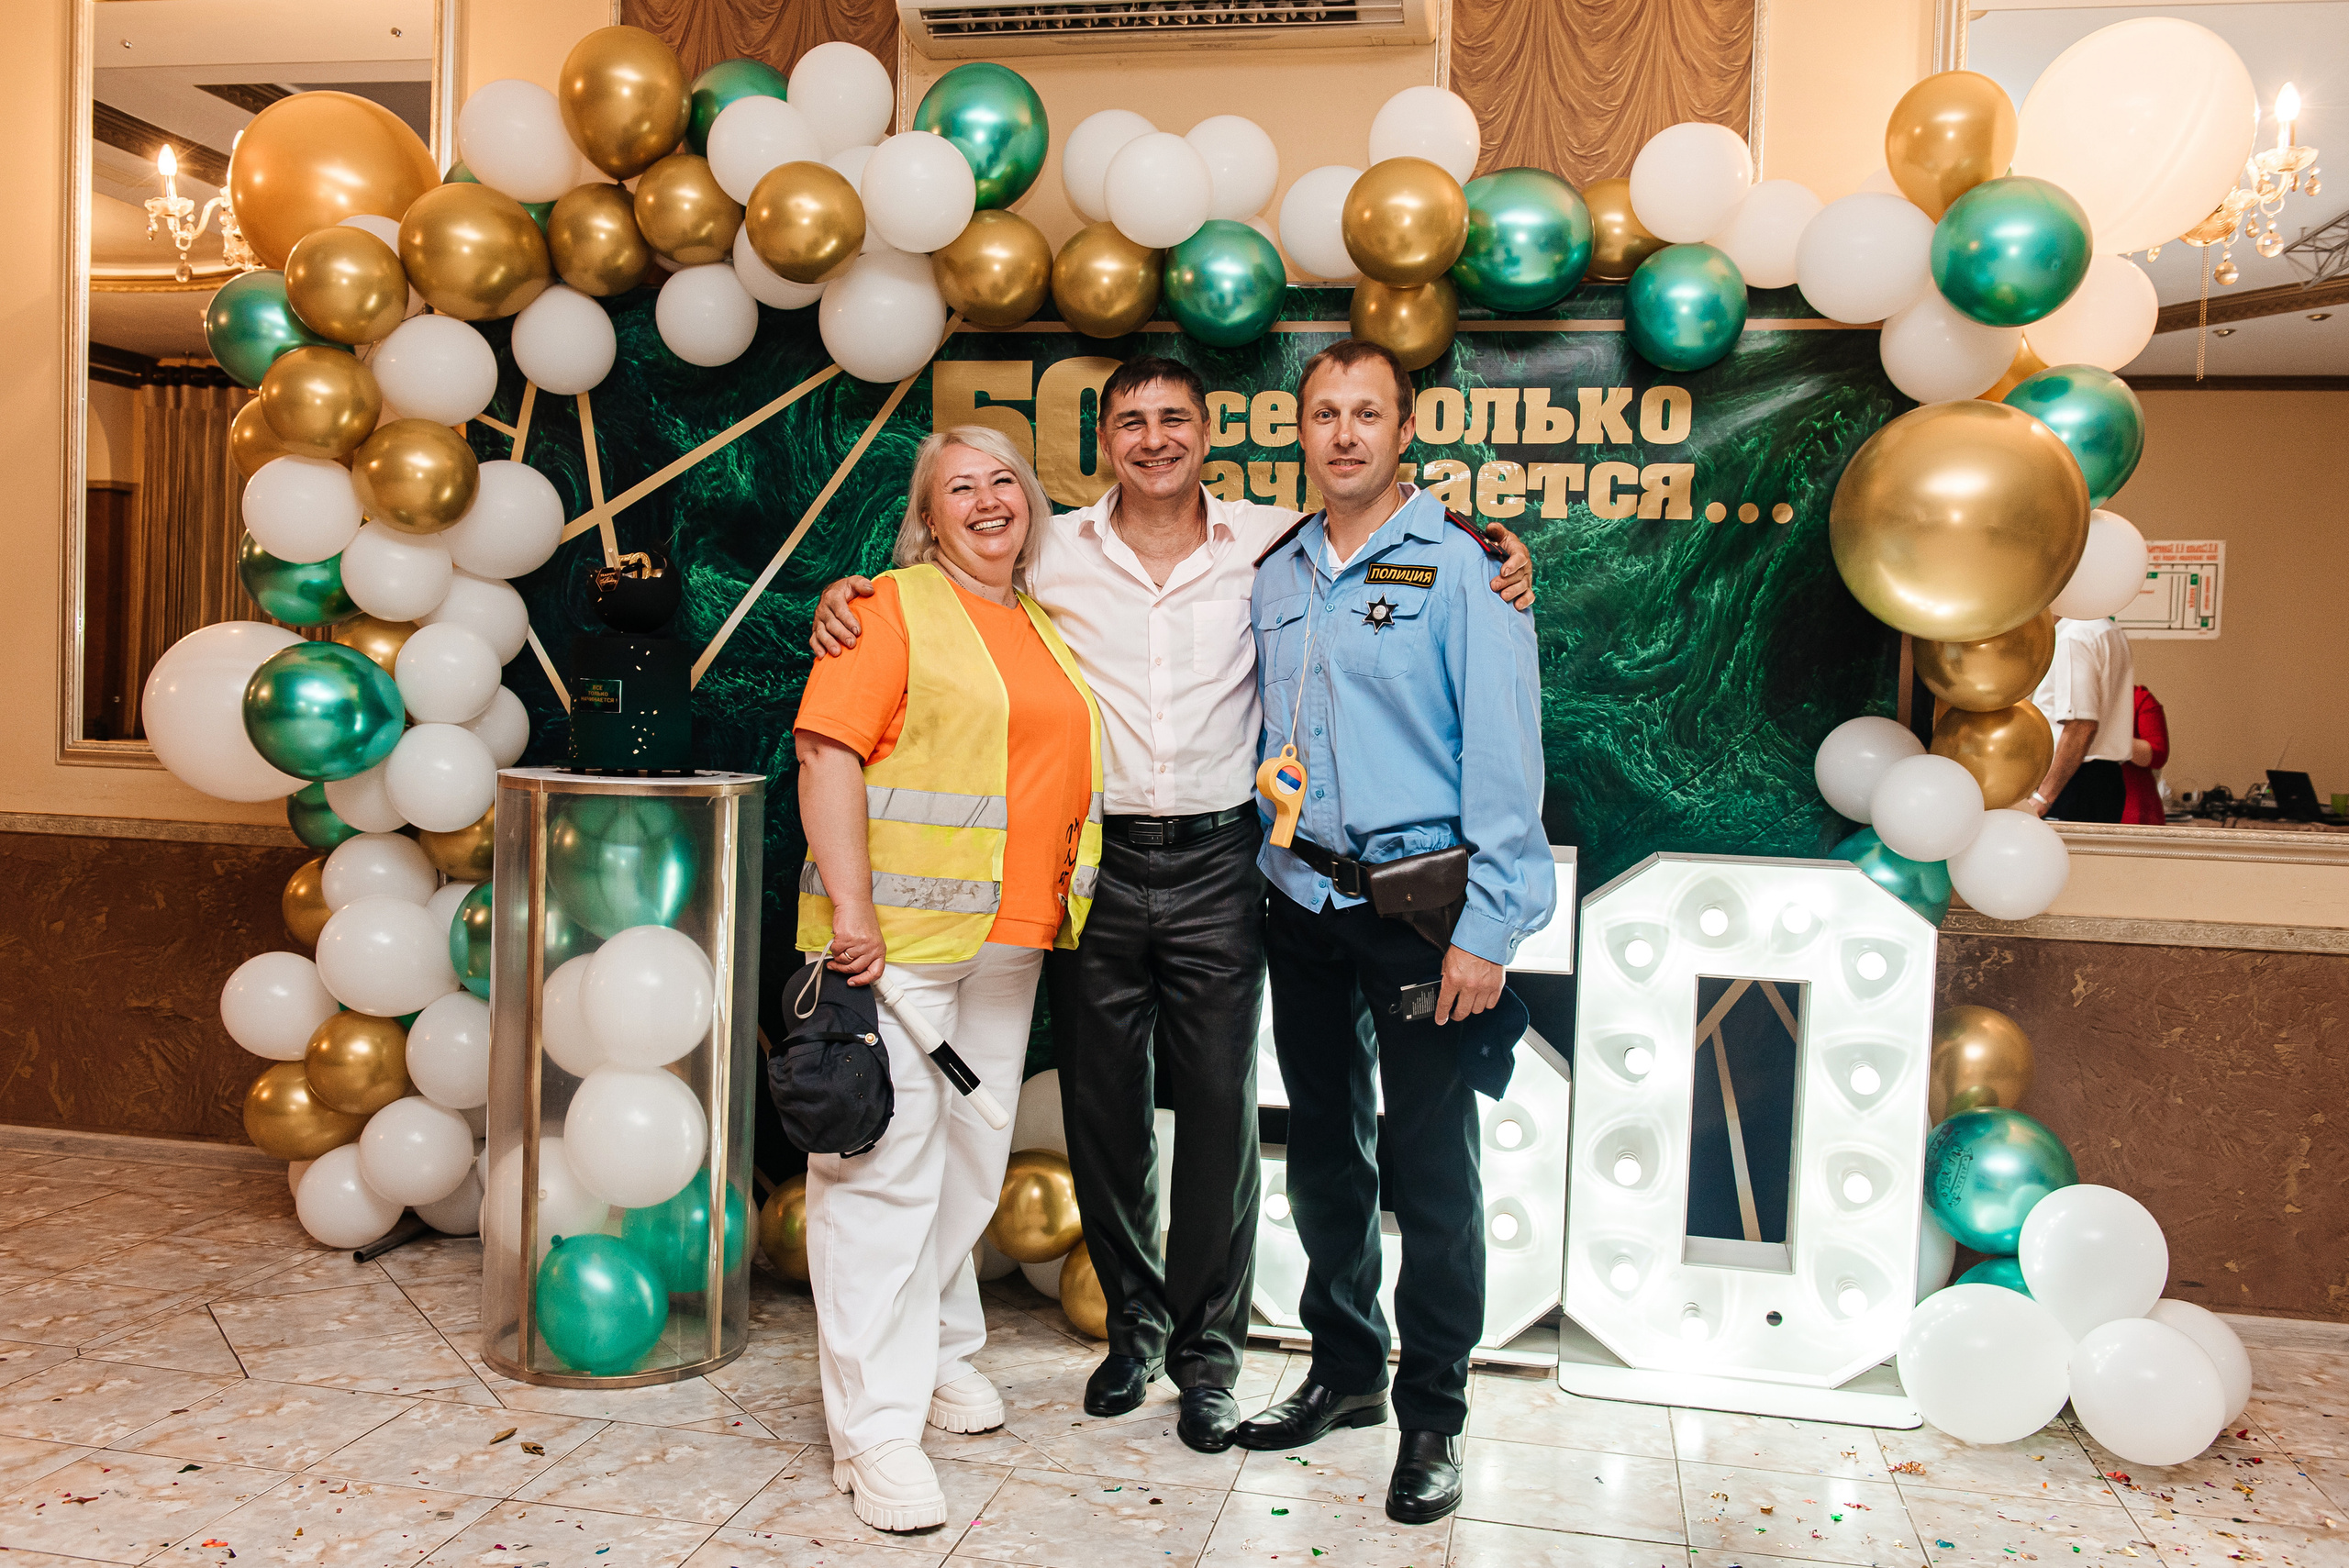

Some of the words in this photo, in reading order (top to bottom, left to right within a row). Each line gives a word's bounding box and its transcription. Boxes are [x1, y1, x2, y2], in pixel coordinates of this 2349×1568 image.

[932, 356, 1125, 507] 50
[1205, 390, 1297, 448] се
[1411, 385, 1692, 445] олько
[1370, 567, 1432, 584] ПОЛИЦИЯ
